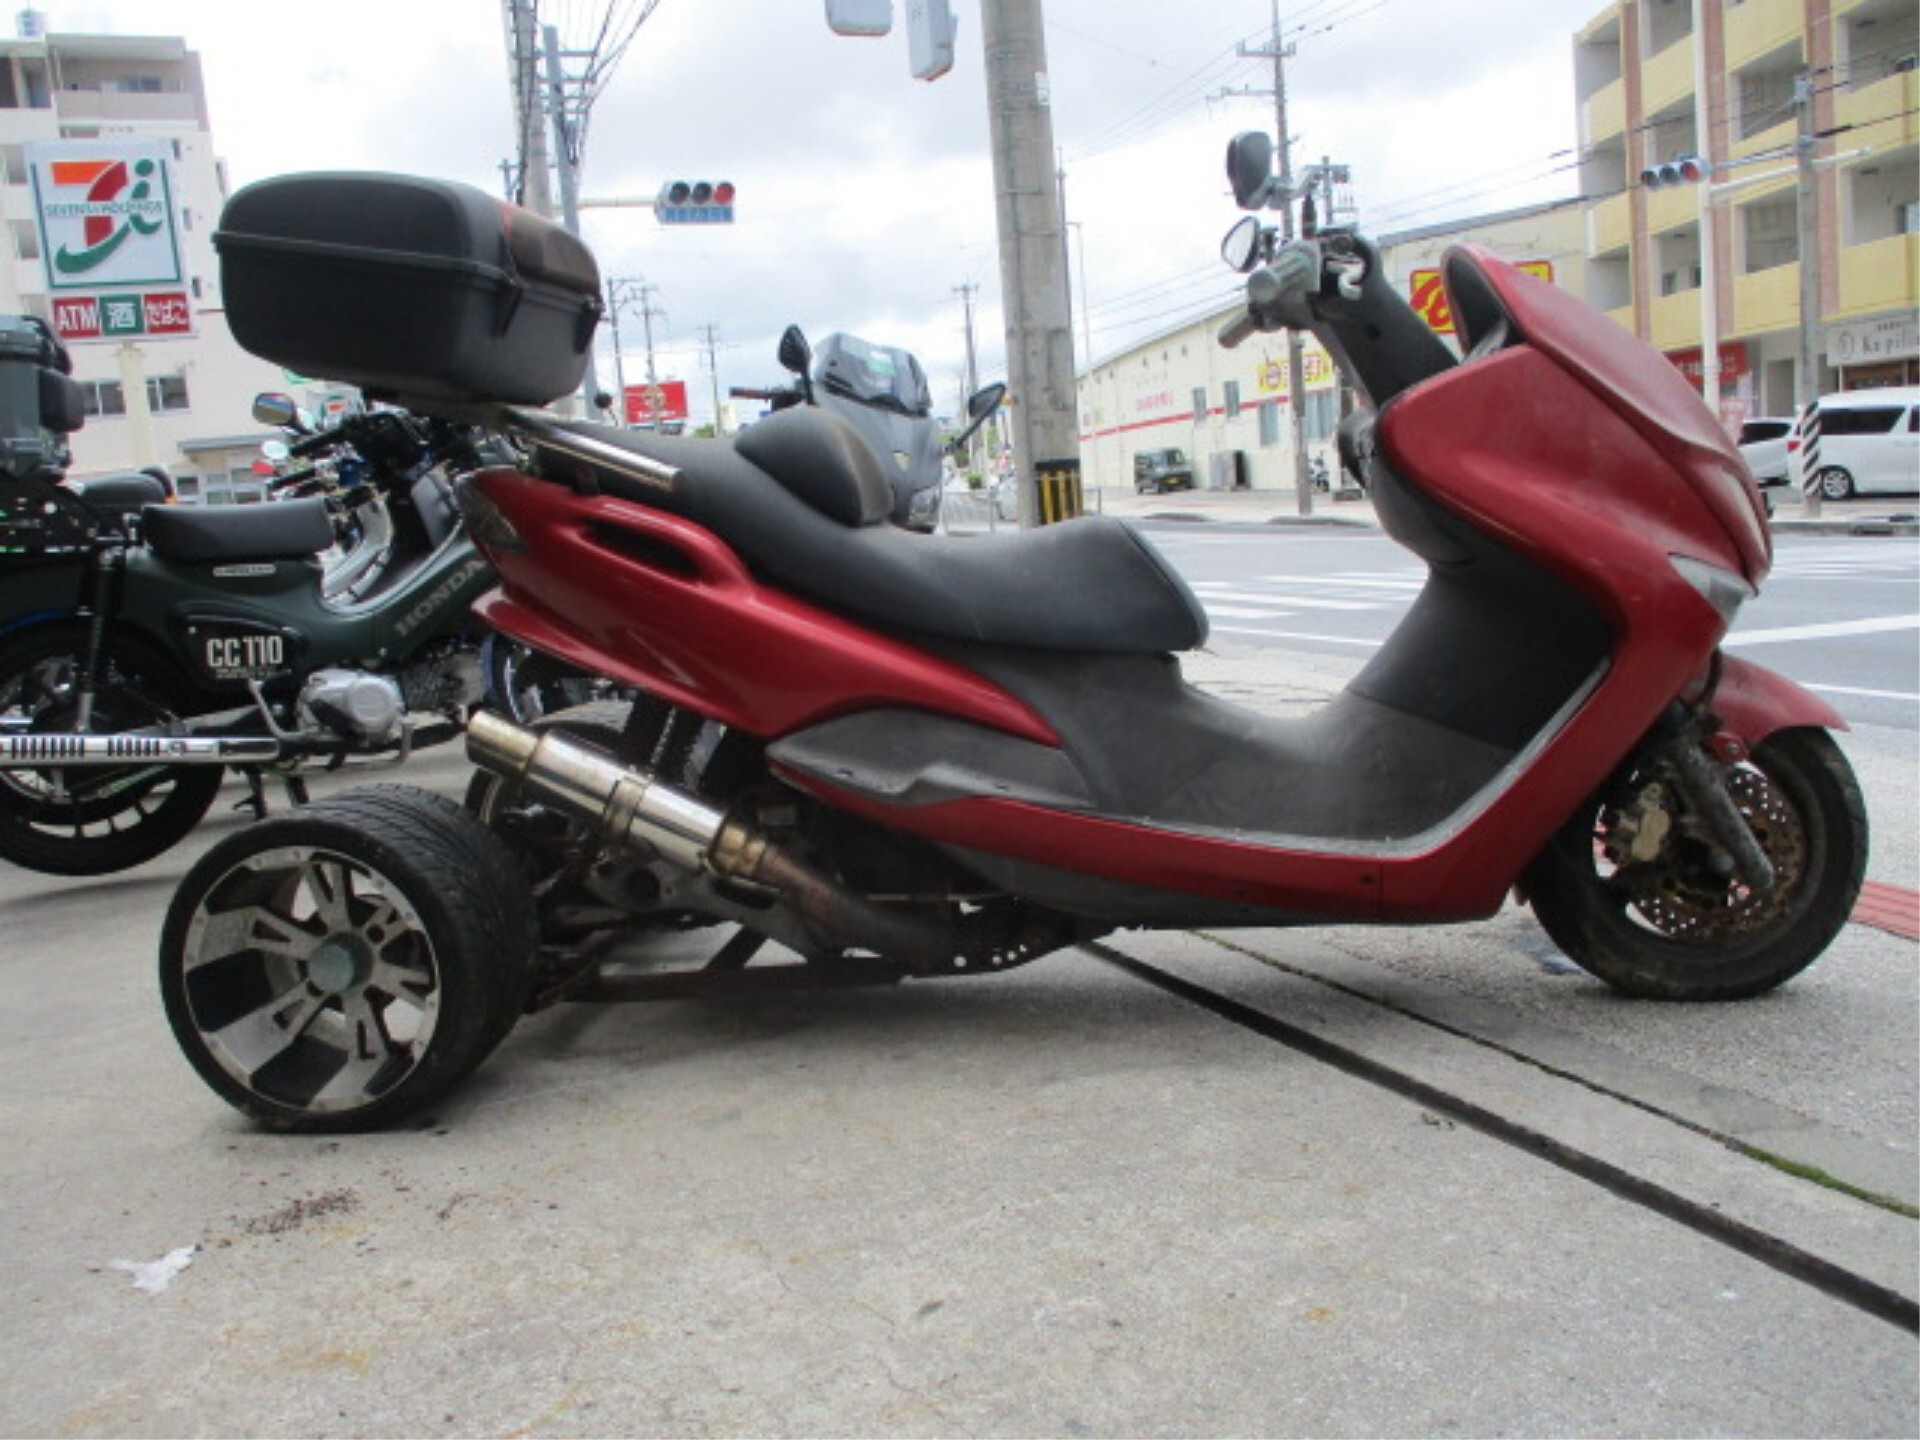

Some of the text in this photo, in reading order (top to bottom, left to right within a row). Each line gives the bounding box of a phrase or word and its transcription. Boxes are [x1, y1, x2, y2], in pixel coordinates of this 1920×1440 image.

[57, 304, 100, 332] ATM
[107, 302, 137, 330] 酒
[145, 300, 189, 326] たばこ
[395, 561, 487, 637] HONDA
